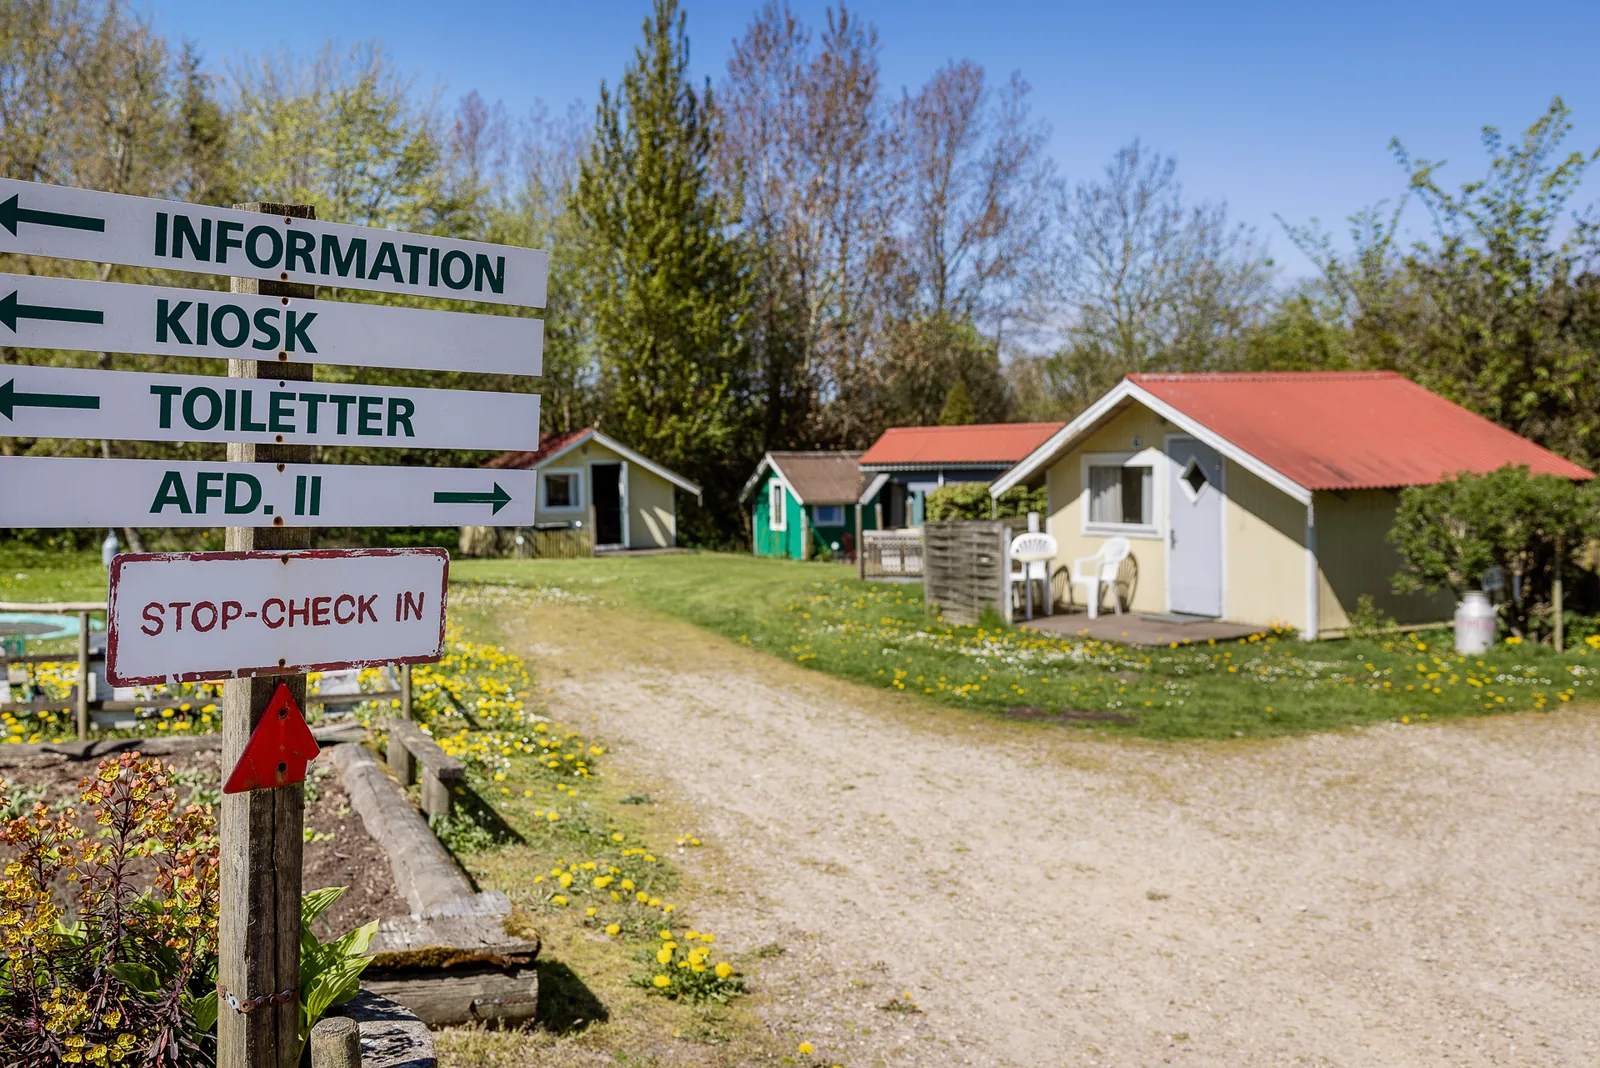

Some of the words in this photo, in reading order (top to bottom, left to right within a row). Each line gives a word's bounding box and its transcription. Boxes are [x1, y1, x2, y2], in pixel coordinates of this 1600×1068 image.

[155, 212, 505, 294] INFORMATION
[156, 299, 318, 353] KIOSK
[150, 385, 415, 437] TOILETTER
[149, 471, 273, 515] AFD.
[295, 476, 321, 515] II
[141, 593, 379, 637] STOP-CHECK
[395, 591, 424, 624] IN
